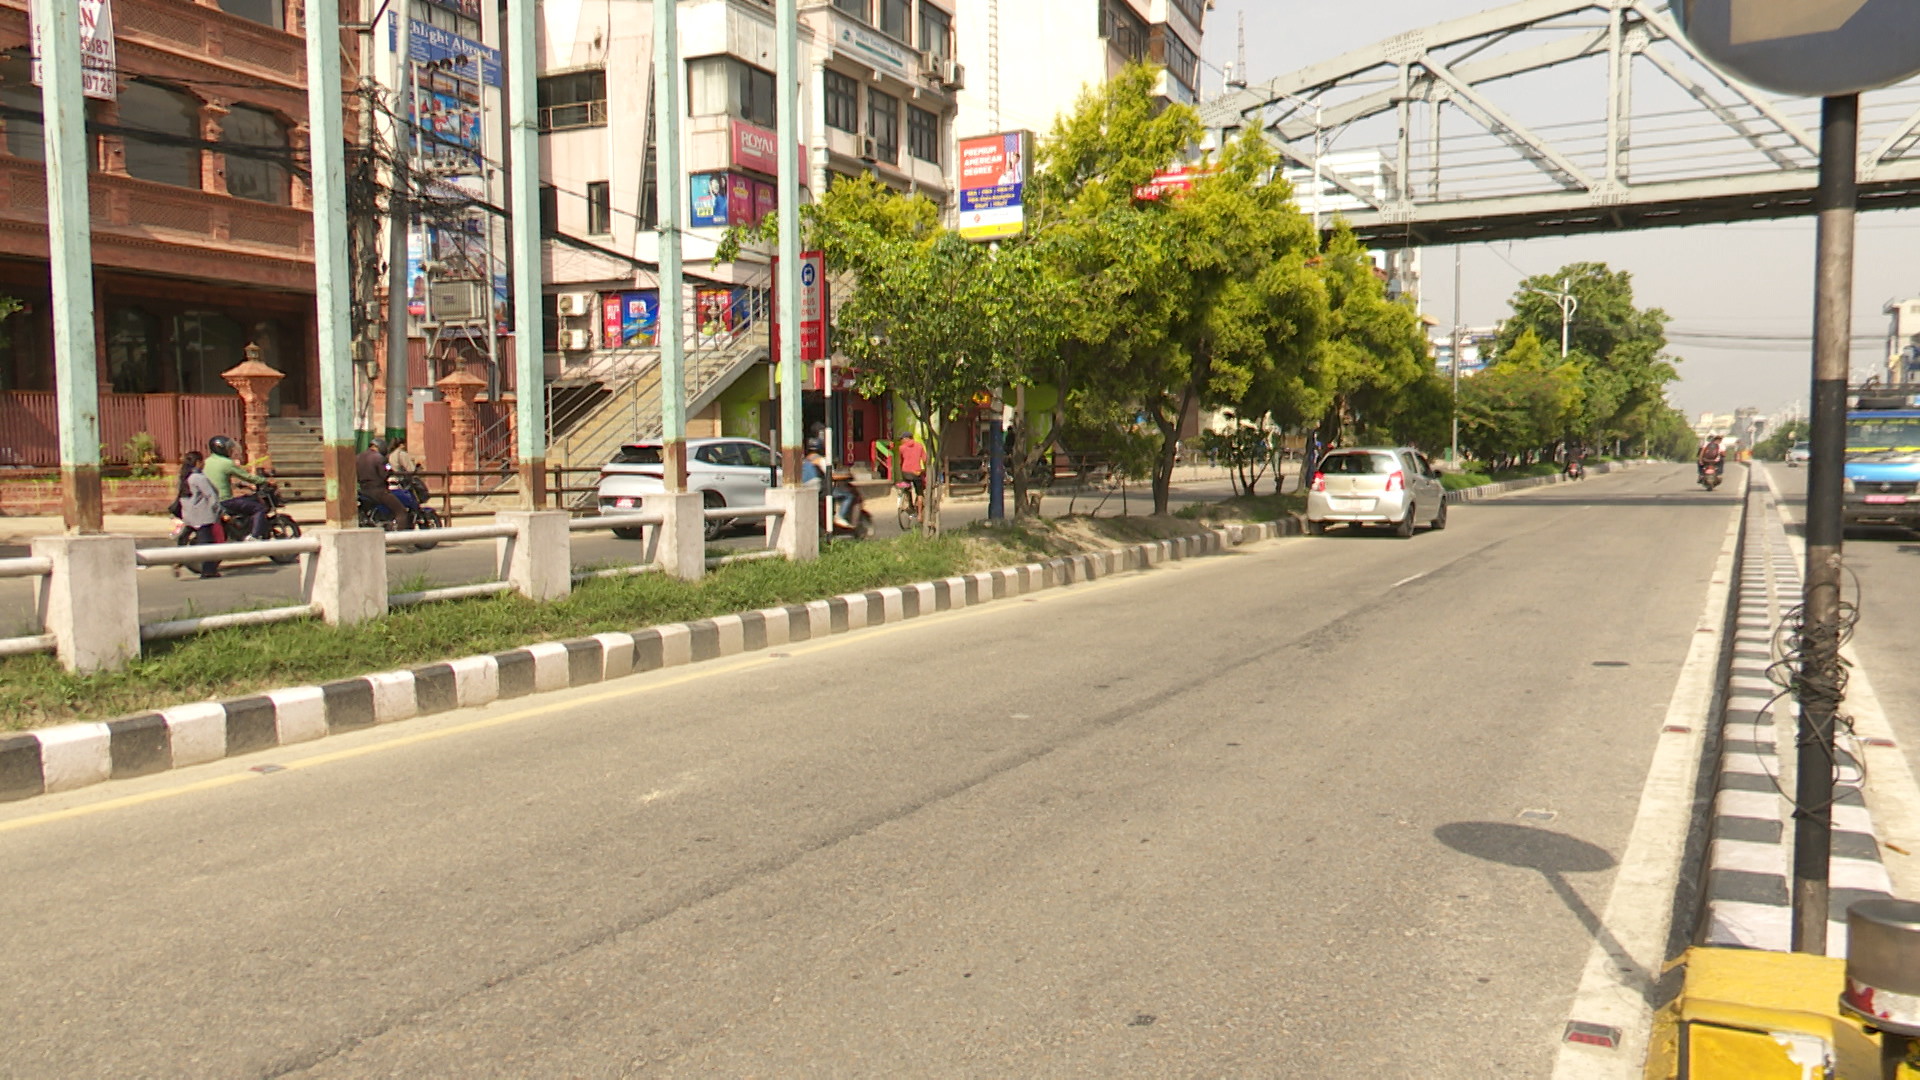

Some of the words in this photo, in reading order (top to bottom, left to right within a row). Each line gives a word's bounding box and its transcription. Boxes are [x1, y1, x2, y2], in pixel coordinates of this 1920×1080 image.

[741, 130, 775, 154] ROYAL
[963, 145, 997, 158] PREMIUM
[964, 155, 1003, 167] AMERICAN
[963, 165, 993, 177] DEGREE
[802, 298, 816, 306] BUS
[801, 308, 817, 317] ONLY
[801, 340, 818, 348] LANE
